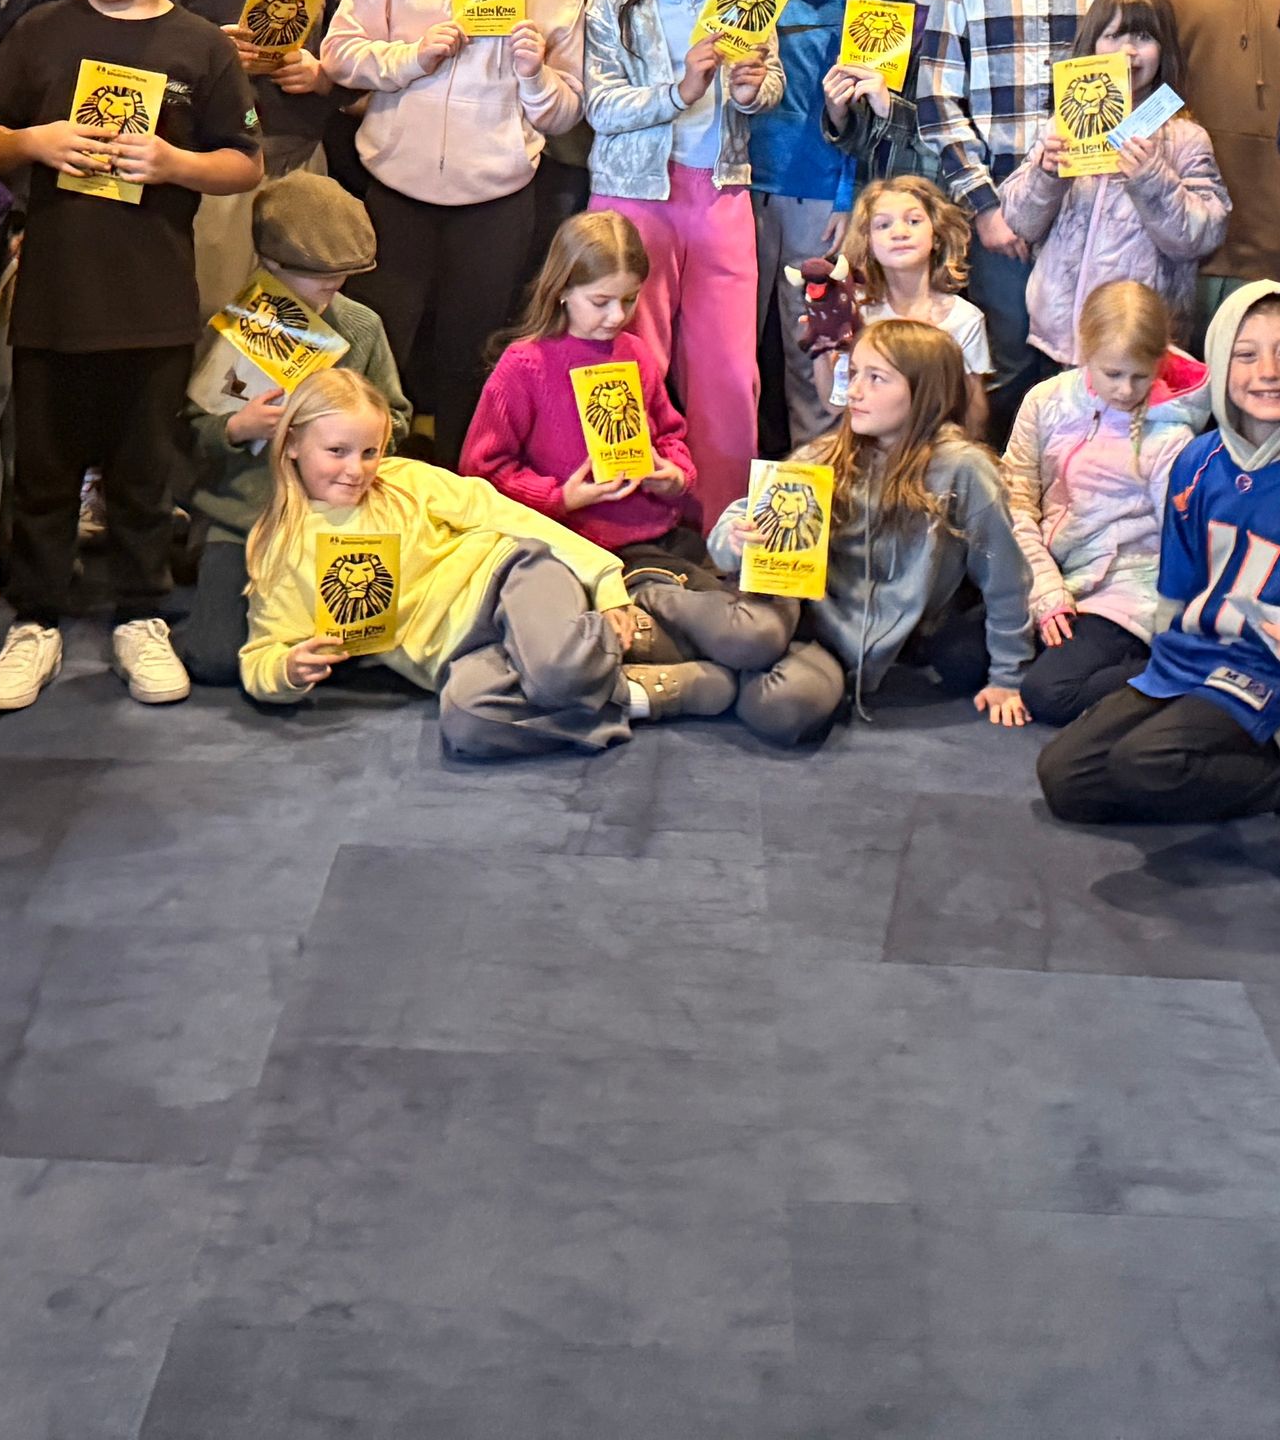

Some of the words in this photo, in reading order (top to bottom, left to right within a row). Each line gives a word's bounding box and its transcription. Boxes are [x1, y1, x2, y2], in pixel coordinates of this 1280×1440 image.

[476, 5, 495, 17] LION
[496, 5, 516, 17] KING
[1081, 143, 1101, 155] LION
